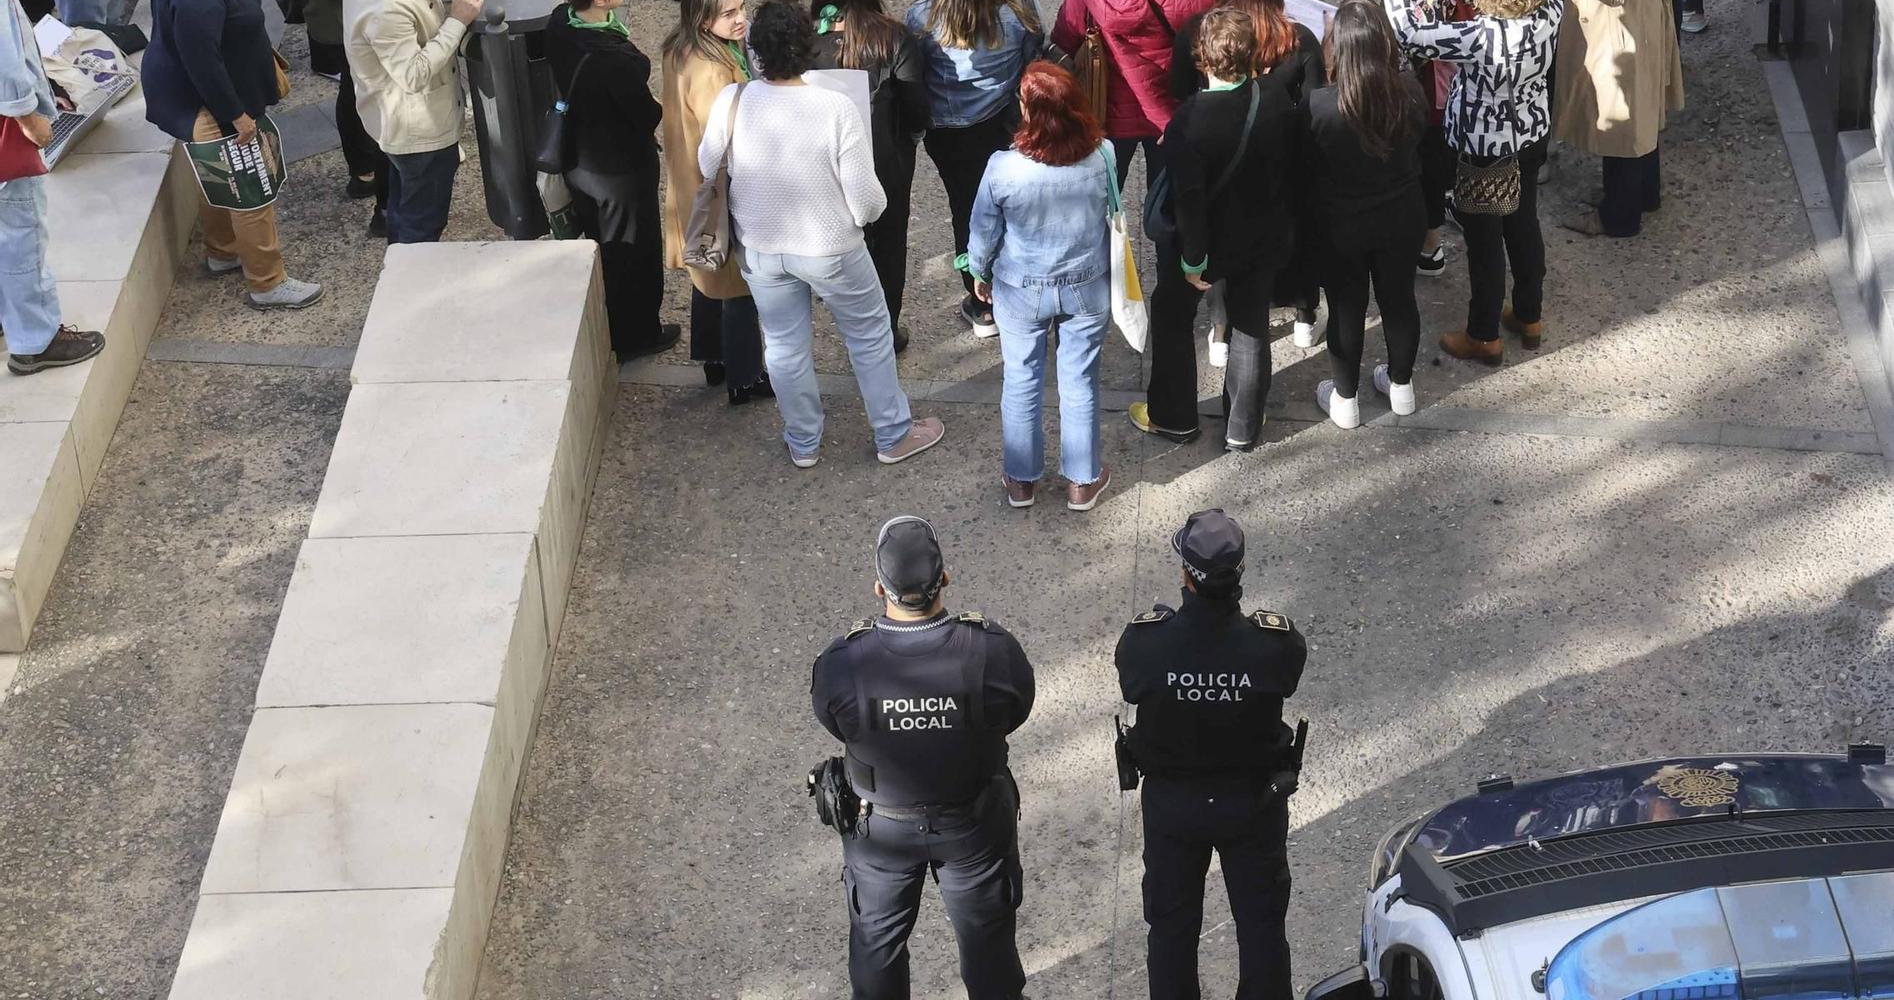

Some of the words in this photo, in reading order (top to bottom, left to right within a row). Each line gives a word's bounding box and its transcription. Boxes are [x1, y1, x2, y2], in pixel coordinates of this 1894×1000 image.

[249, 136, 273, 197] VORTAMENT
[1167, 672, 1252, 688] POLICIA
[1176, 688, 1243, 701] LOCAL
[882, 696, 958, 714] POLICIA
[889, 716, 953, 731] LOCAL
